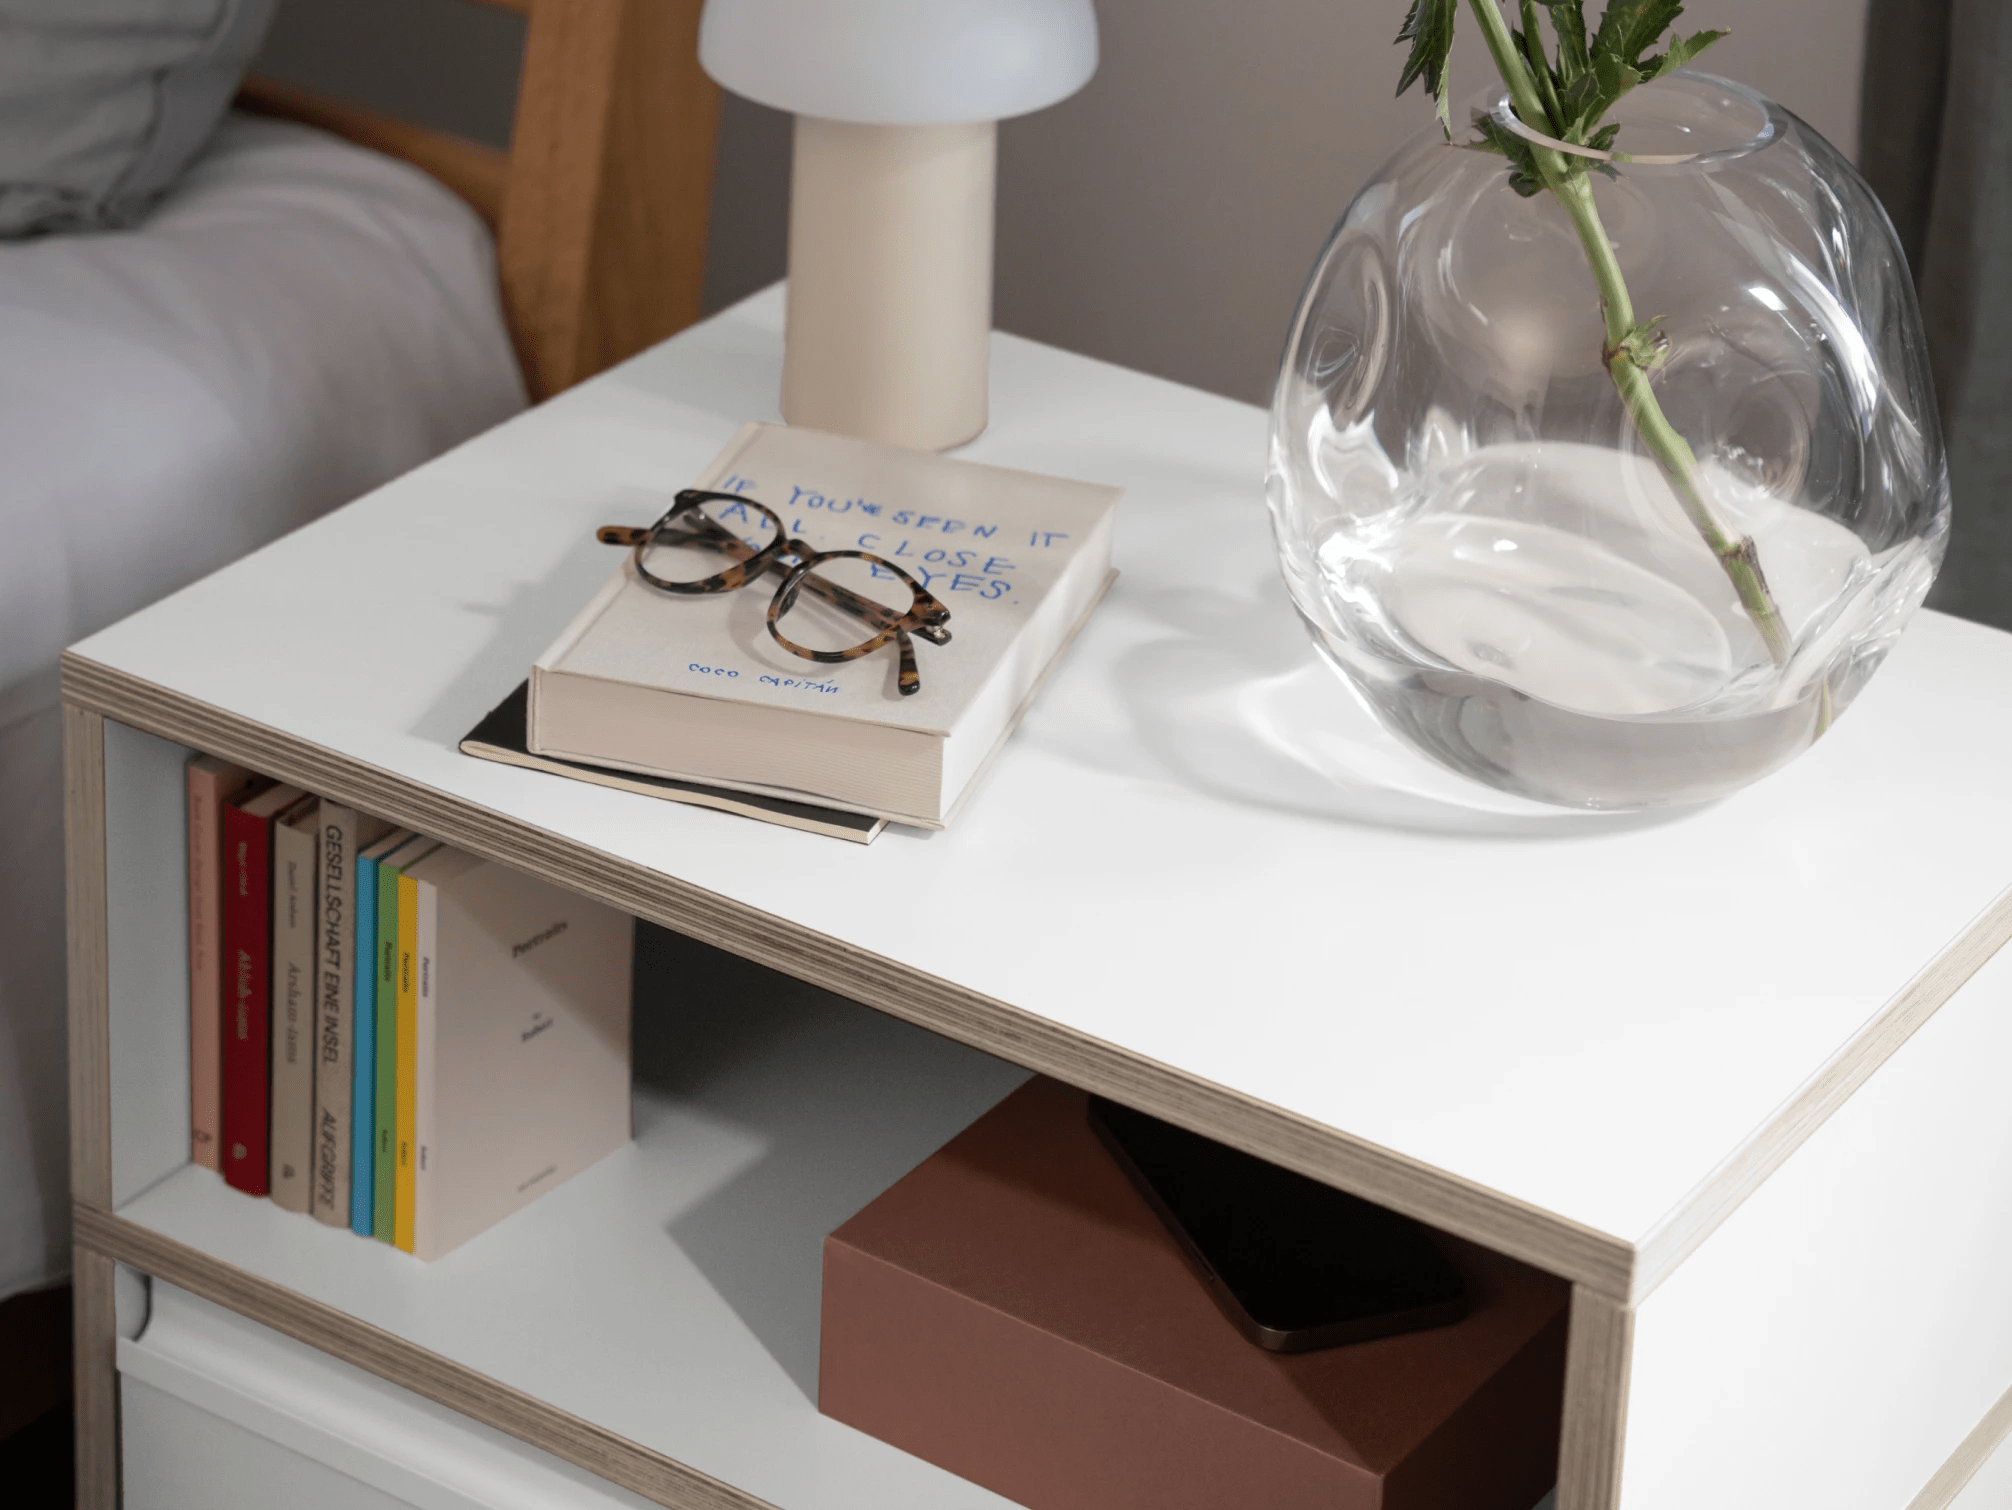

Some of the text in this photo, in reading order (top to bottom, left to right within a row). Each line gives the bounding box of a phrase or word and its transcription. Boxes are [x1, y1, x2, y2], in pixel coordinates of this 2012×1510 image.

[722, 475, 756, 494] IF
[892, 510, 998, 539] SEEN
[1031, 531, 1070, 549] IT
[857, 533, 1016, 577] CLOSE
[688, 662, 739, 678] COCO
[321, 823, 344, 1066] GESELLSCHAFT EINE INSEL
